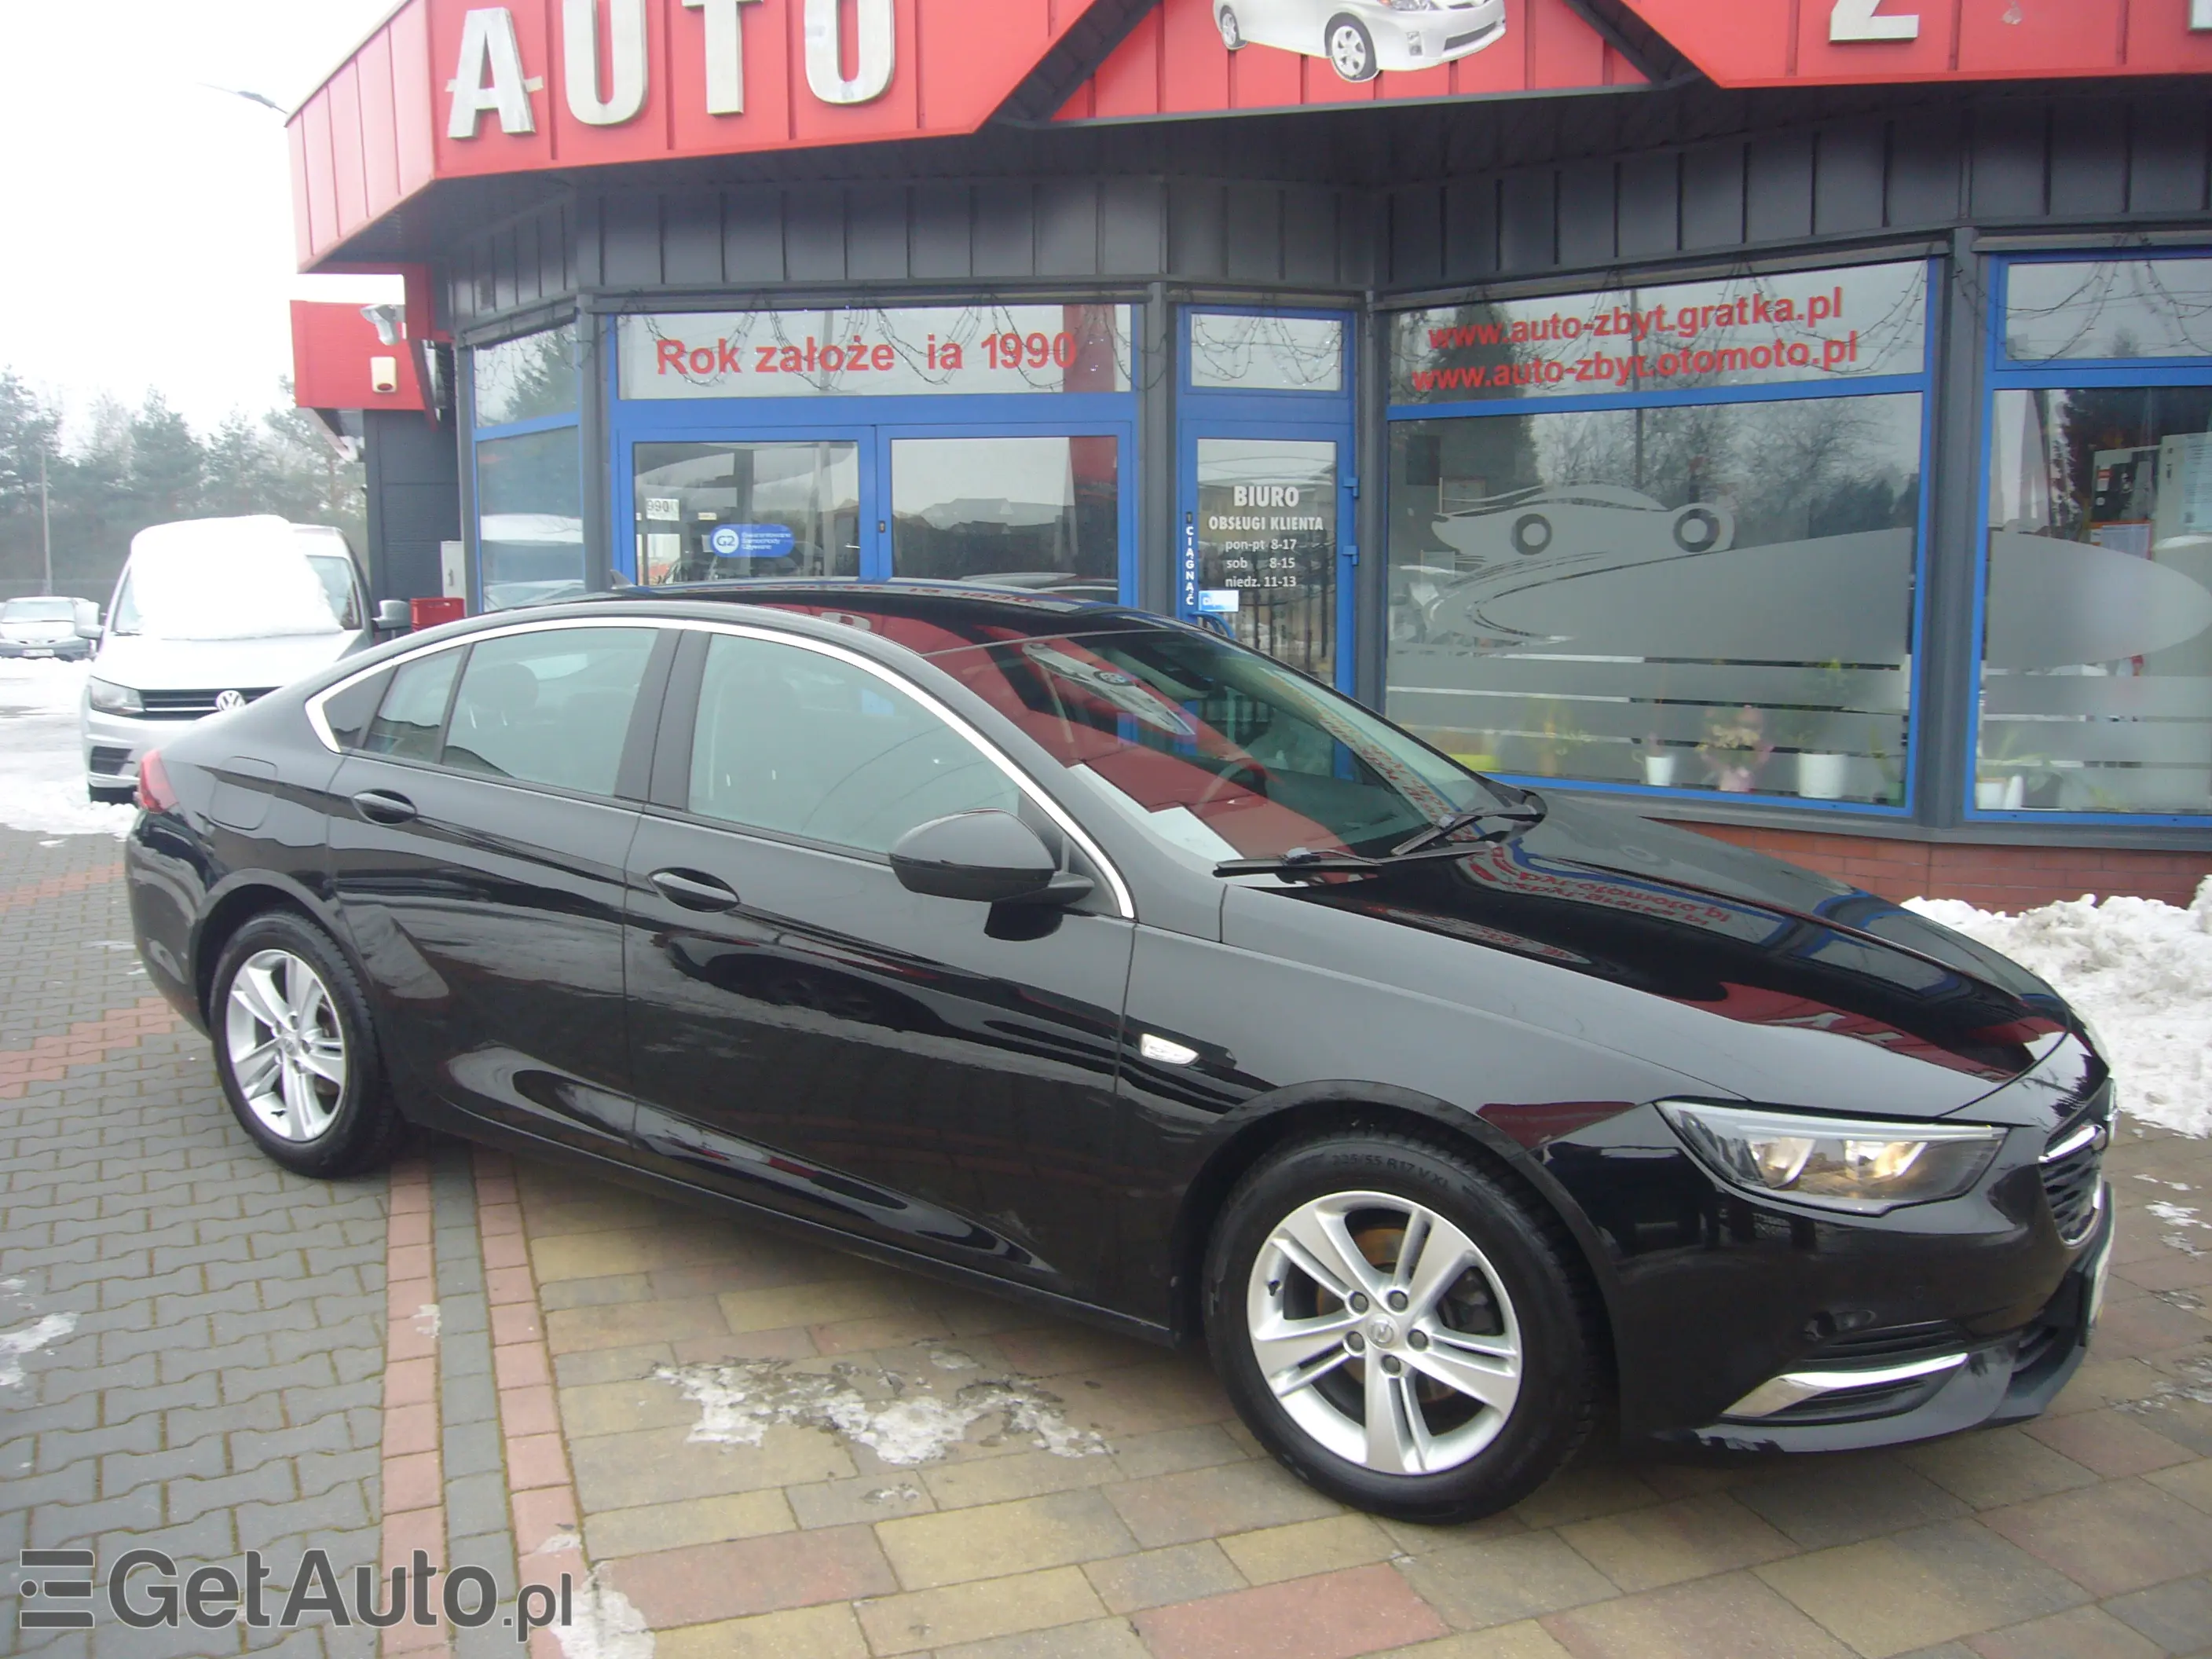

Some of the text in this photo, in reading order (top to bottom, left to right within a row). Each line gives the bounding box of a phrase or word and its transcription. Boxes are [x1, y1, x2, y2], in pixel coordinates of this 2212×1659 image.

[445, 0, 897, 139] AUTO
[1428, 286, 1843, 350] www.auto-zbyt.gratka.pl
[656, 338, 743, 375] Rok
[981, 331, 1078, 369] 1990
[1412, 330, 1859, 392] www.auto-zbyt.otomoto.pl
[1233, 485, 1299, 507] BIURO
[1208, 515, 1324, 530] OBSŁUGI KLIENTA
[716, 535, 736, 548] G2
[1225, 539, 1297, 552] pon-pt 8-17
[1226, 557, 1296, 569] sob 8-15
[1225, 576, 1297, 588] niedz. 11-13
